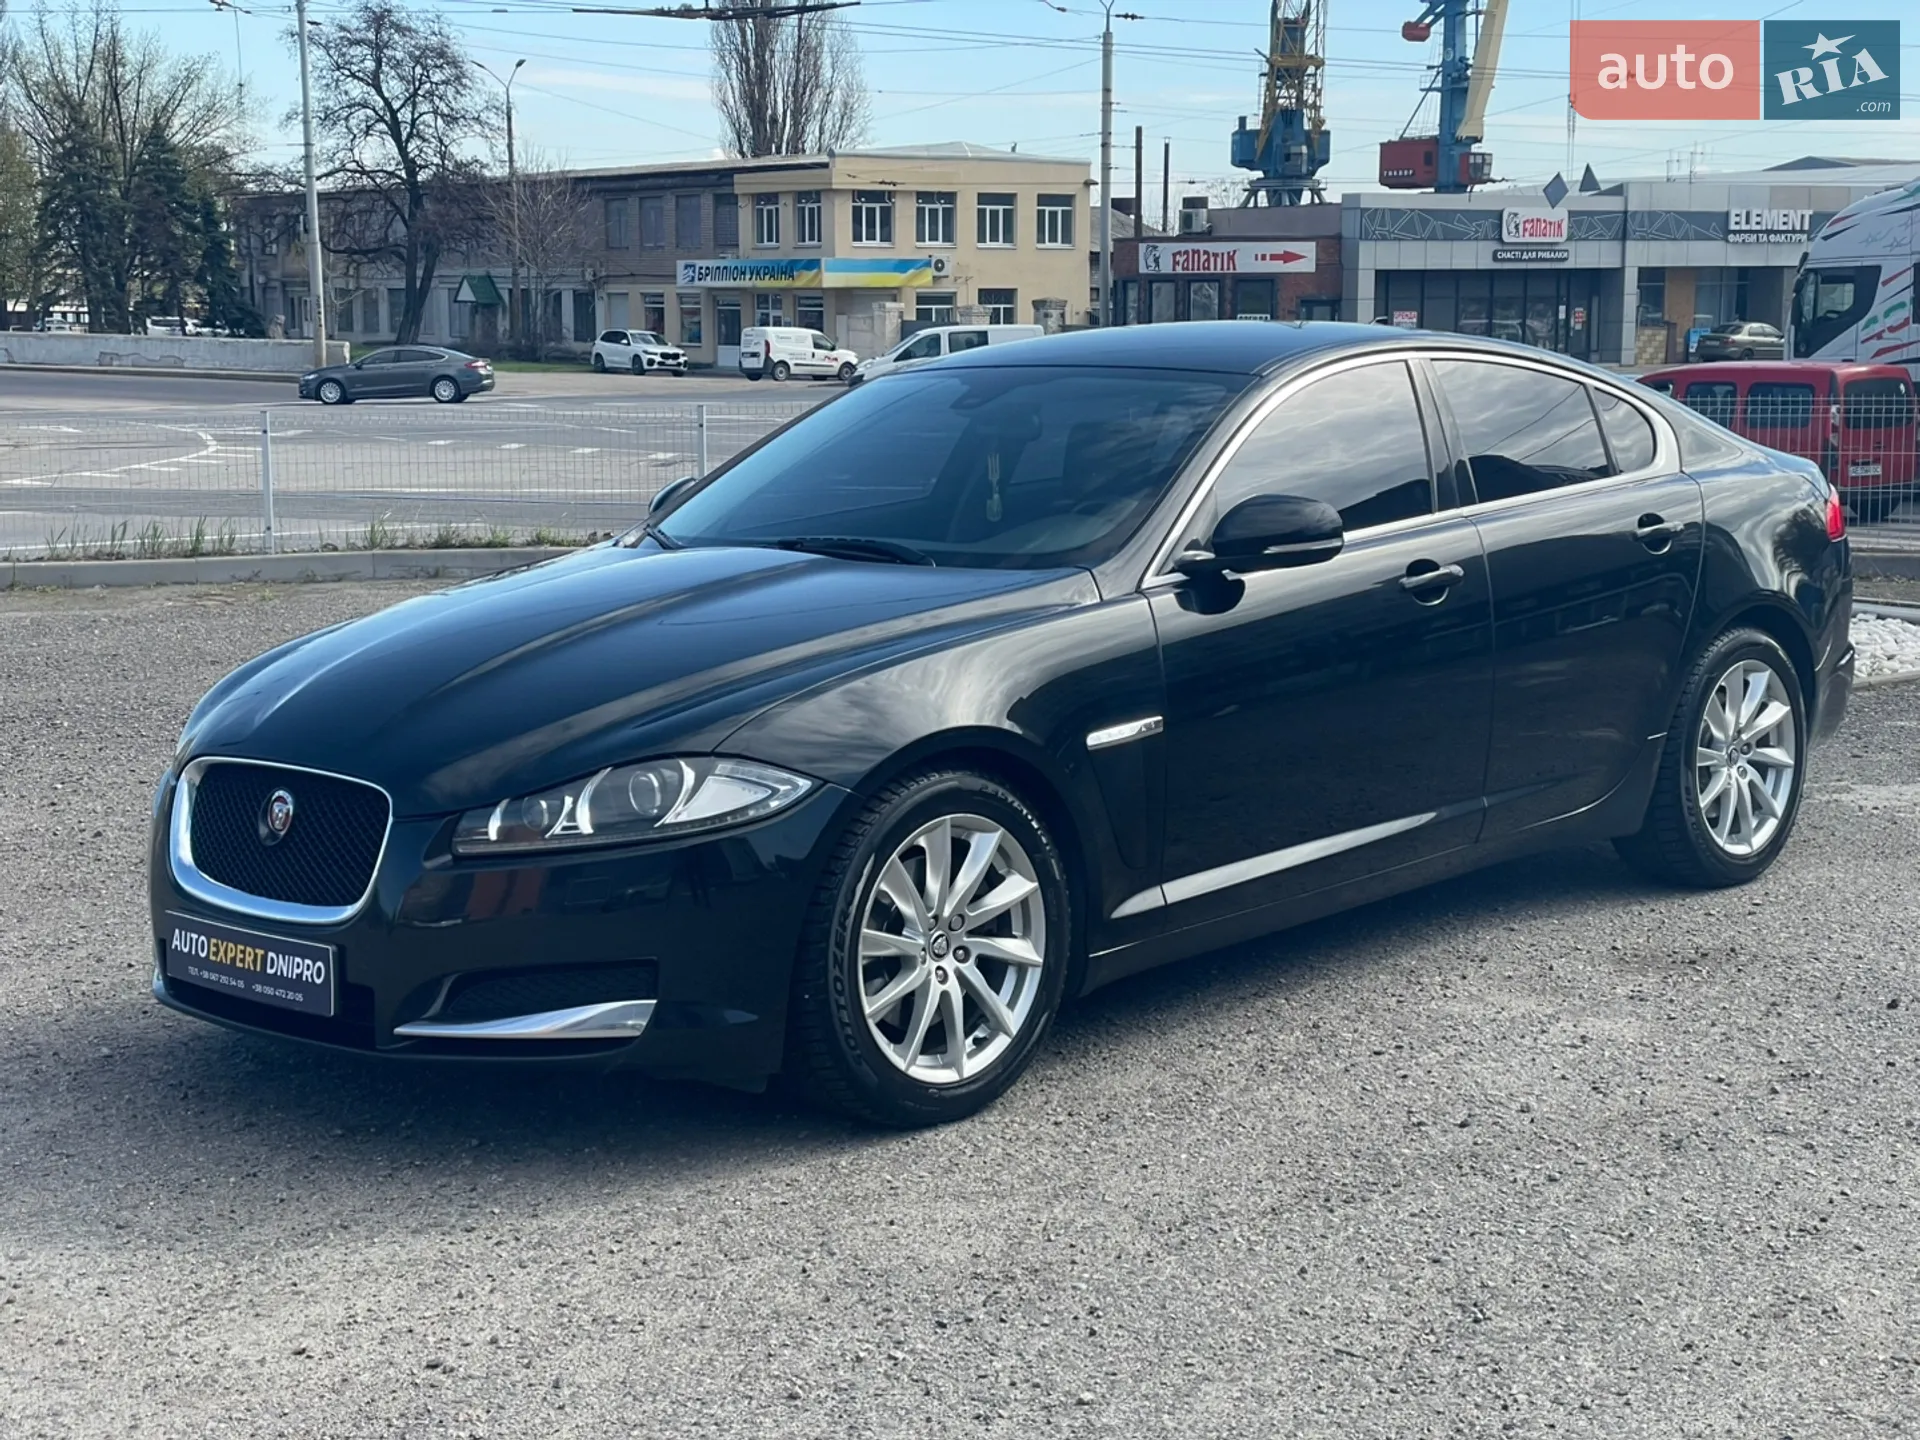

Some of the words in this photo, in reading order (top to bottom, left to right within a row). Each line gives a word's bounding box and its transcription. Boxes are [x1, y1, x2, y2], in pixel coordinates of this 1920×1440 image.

[1728, 209, 1814, 230] ELEMENT
[1727, 233, 1757, 243] ФАРБИ
[1758, 233, 1768, 243] ТА
[1768, 233, 1808, 243] ФАКТУРИ
[1497, 251, 1521, 259] СНАСТІ
[1521, 251, 1536, 260] ДЛЯ
[1537, 251, 1568, 259] РИБАЛКИ
[748, 263, 795, 281] УКРАЇНА
[171, 928, 208, 958] AUTO
[208, 938, 265, 972] EXPERT
[266, 951, 325, 984] DNIPRO
